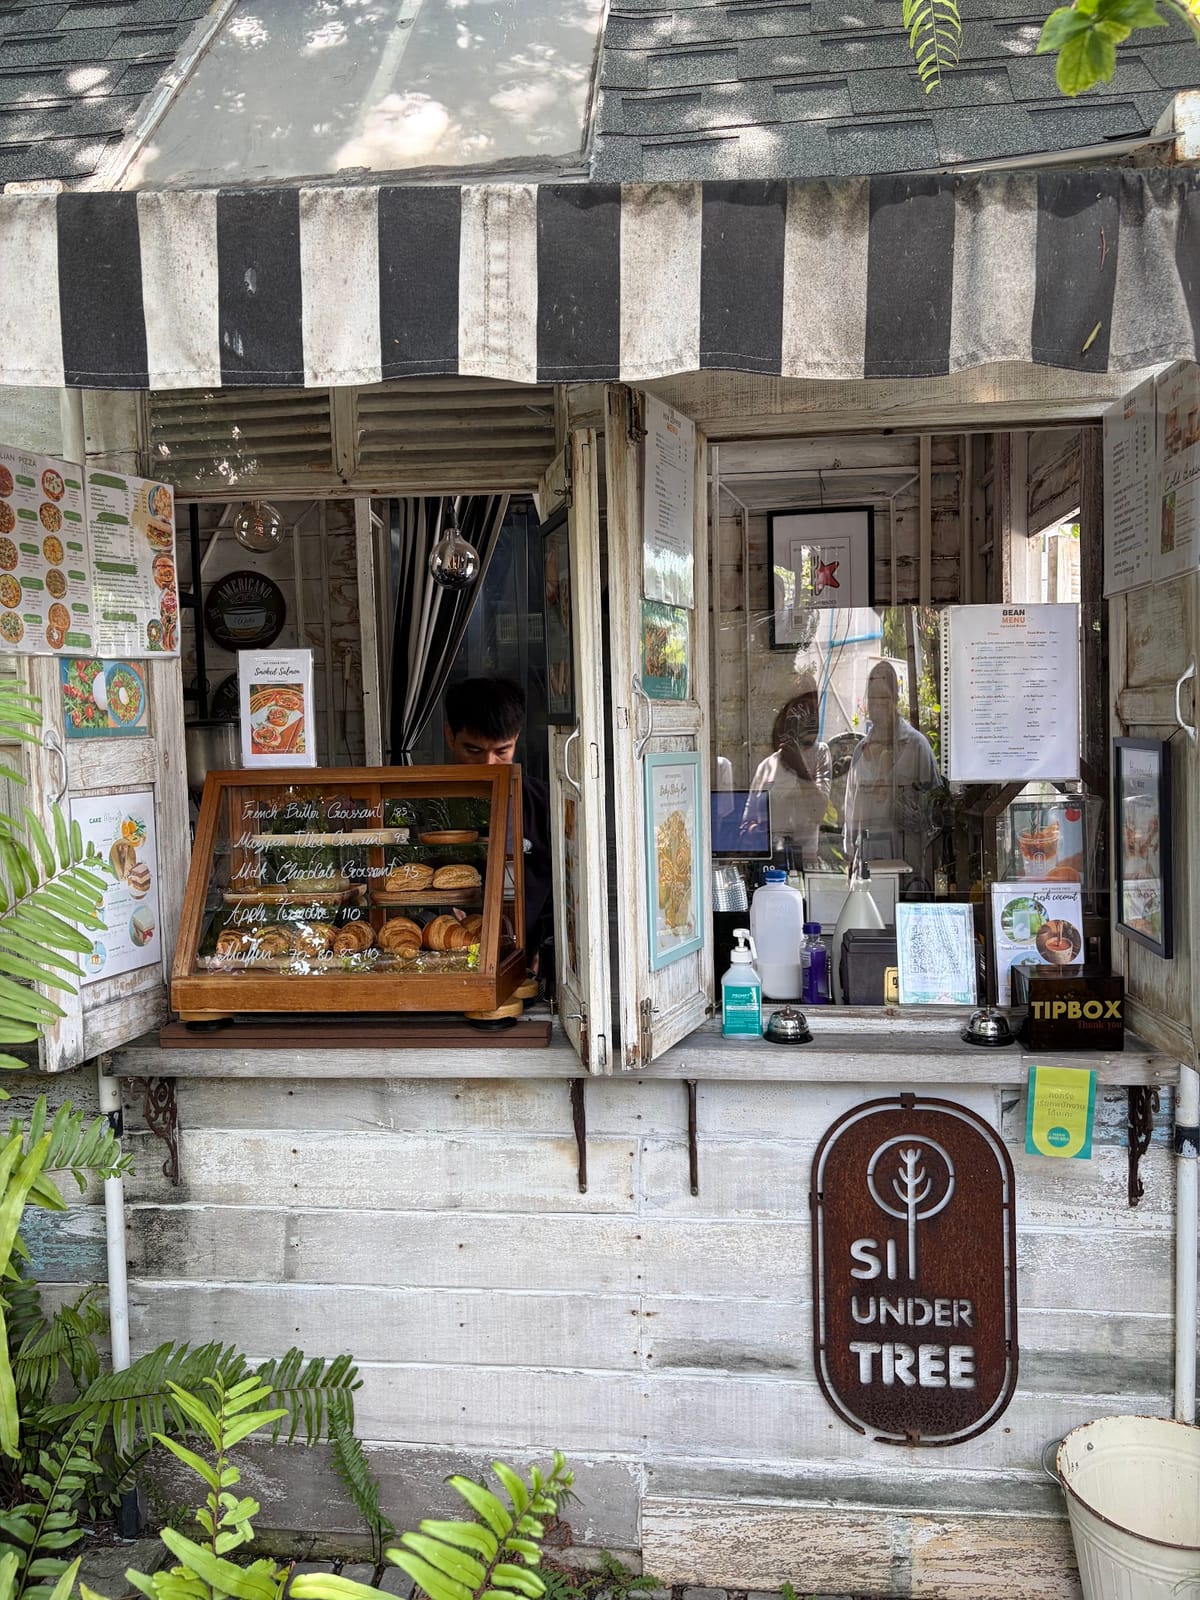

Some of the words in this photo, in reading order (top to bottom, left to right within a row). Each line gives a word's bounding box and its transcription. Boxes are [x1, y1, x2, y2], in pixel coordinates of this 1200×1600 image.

[217, 577, 273, 600] AMERICANO
[254, 667, 277, 676] Smoked
[278, 666, 300, 676] Salmon
[242, 800, 277, 820] French
[327, 801, 381, 819] Croissant
[330, 828, 384, 847] Croissant
[276, 860, 335, 882] Chocolate
[340, 859, 396, 878] Croissant
[403, 865, 419, 879] 95
[1052, 891, 1078, 901] coconut
[217, 941, 274, 966] Muffin
[1031, 1000, 1122, 1020] TIPBOX
[1078, 1020, 1104, 1029] Thank
[851, 1295, 974, 1328] UNDER
[849, 1341, 978, 1389] TREE
